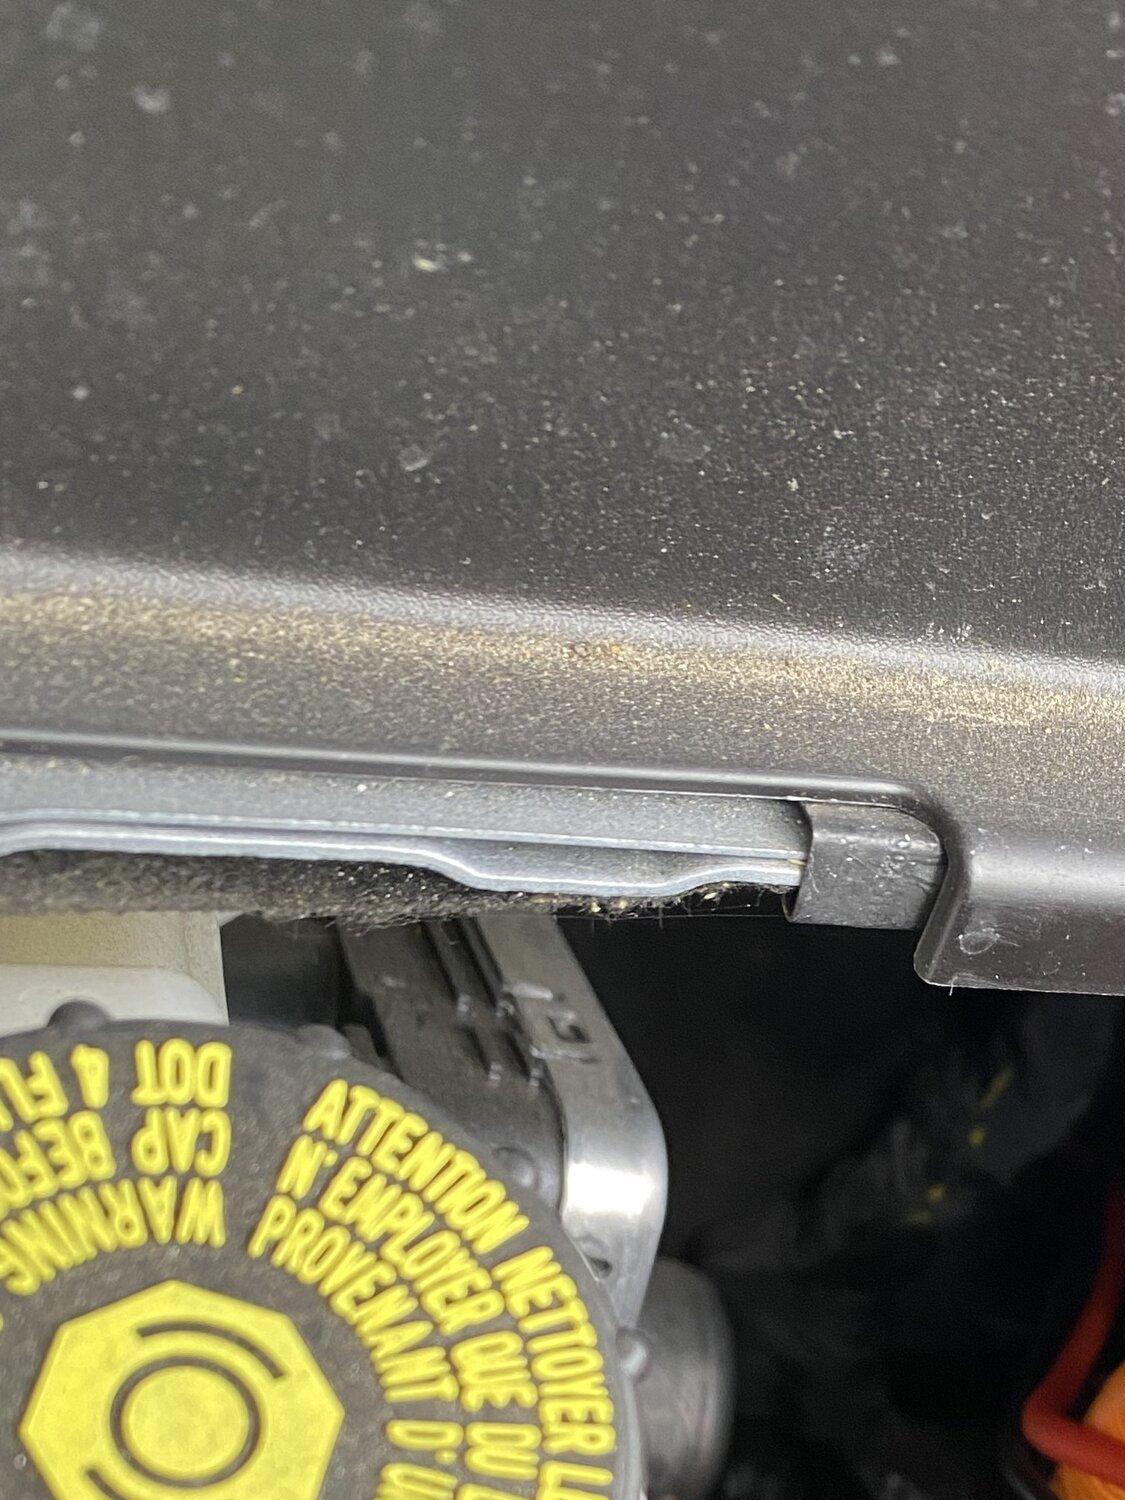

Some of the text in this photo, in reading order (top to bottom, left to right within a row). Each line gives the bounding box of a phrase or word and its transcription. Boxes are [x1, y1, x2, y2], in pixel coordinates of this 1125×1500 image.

[0, 1038, 232, 1131] DOT 4 FL
[0, 1107, 232, 1219] CAP BEFO
[246, 1194, 459, 1405] PROVENANT
[302, 1079, 531, 1254] ATTENTION
[492, 1245, 617, 1457] NETTOYER
[450, 1330, 539, 1413] QUE
[464, 1421, 542, 1480] DU
